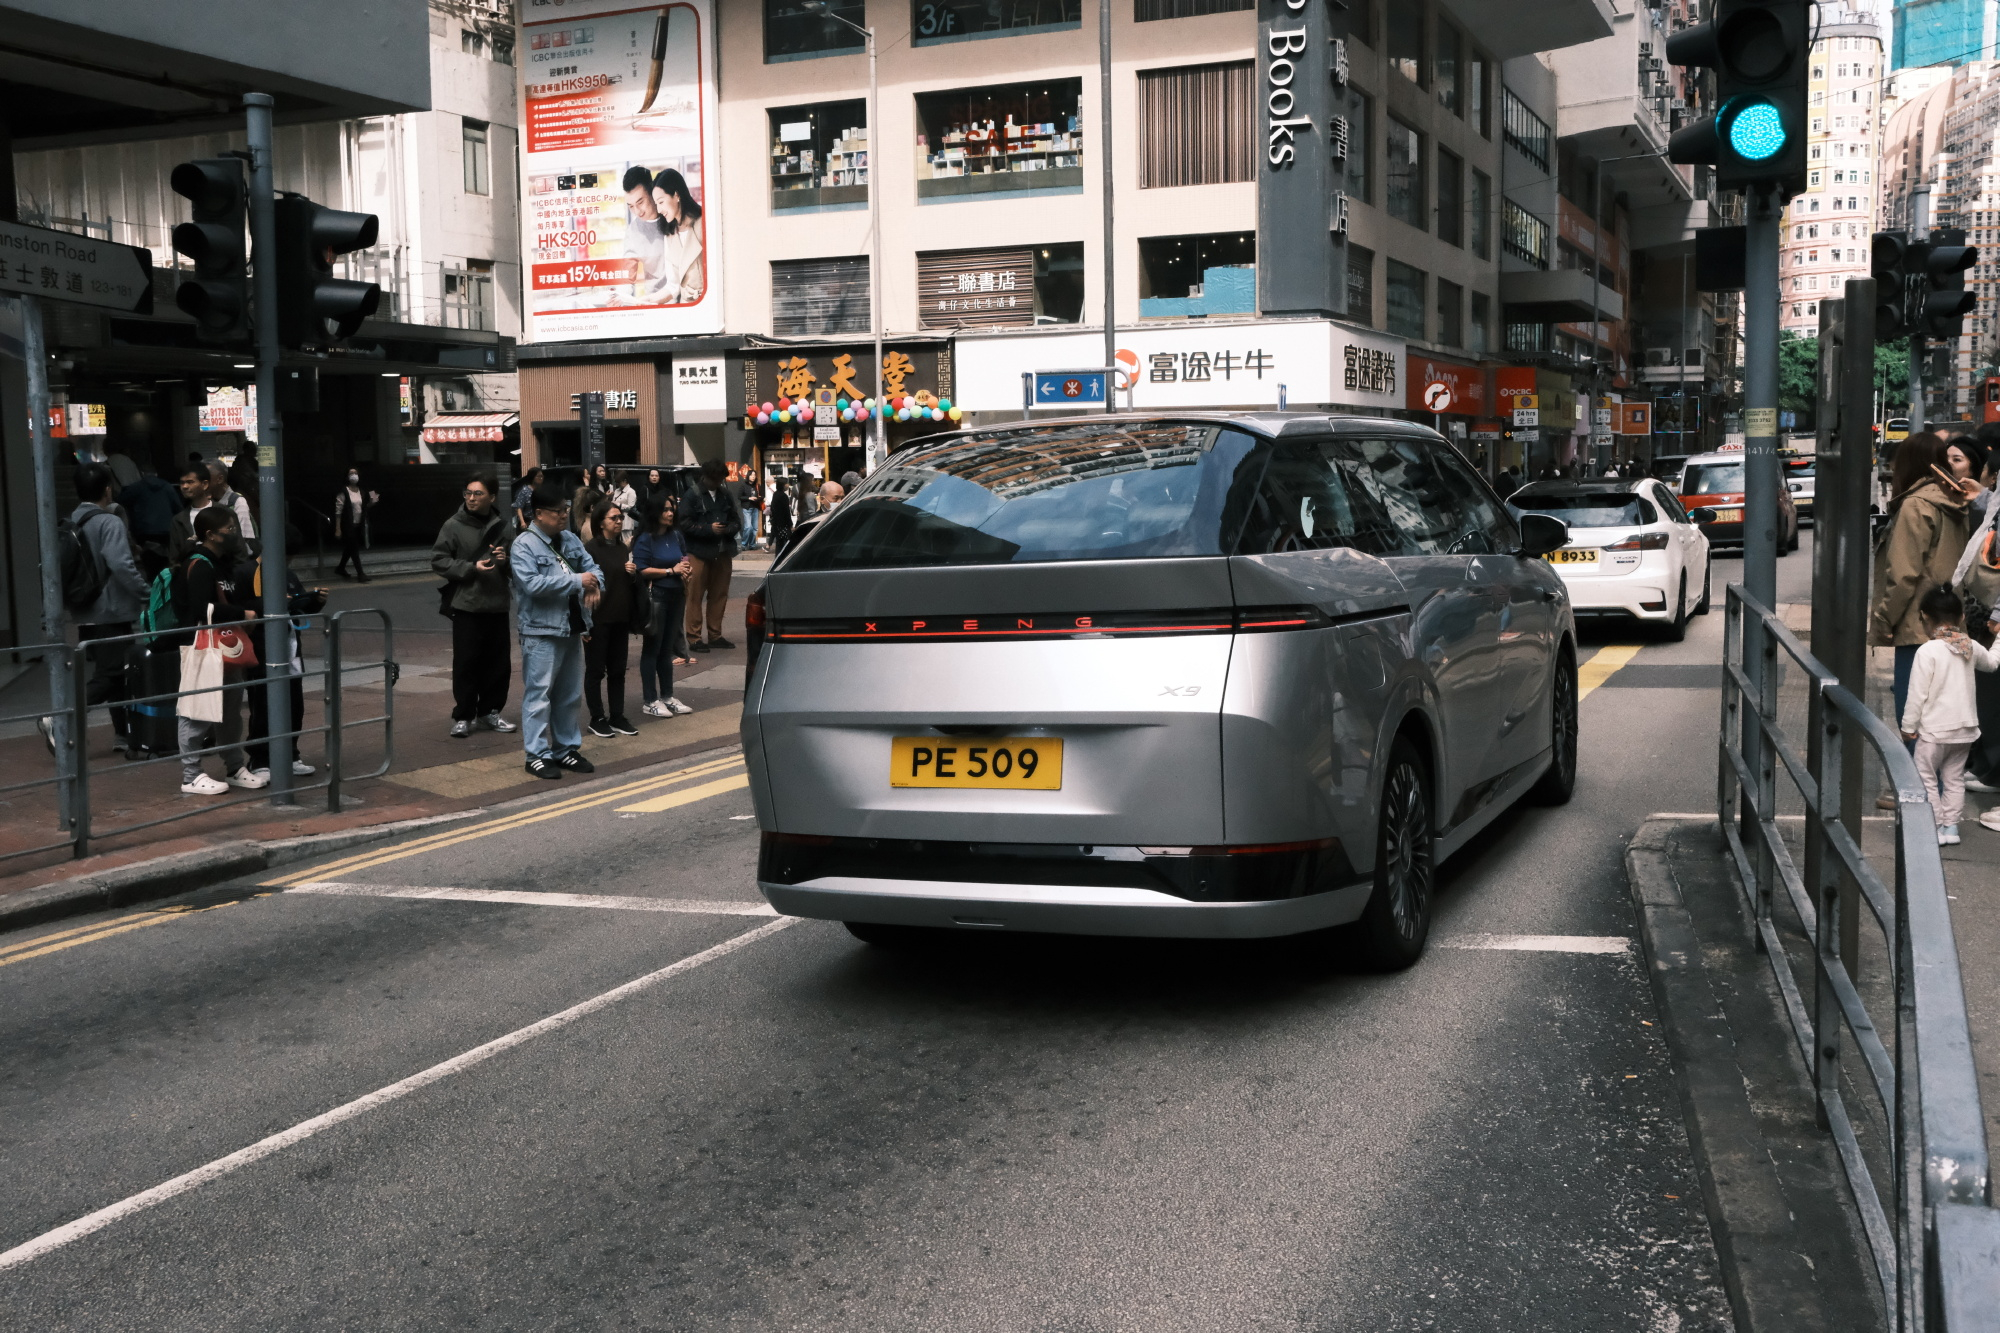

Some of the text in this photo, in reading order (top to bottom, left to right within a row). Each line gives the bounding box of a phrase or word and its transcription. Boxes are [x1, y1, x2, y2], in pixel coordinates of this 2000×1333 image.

[920, 4, 955, 34] 3/F
[1268, 24, 1313, 165] Books
[965, 125, 1036, 156] SALE
[604, 194, 617, 203] Pay
[538, 230, 597, 249] HK$200
[56, 241, 97, 263] Road
[938, 271, 1016, 294] 三聯書店
[540, 324, 599, 333] www.icbcasia.com
[1148, 348, 1274, 383] 富途牛牛
[1344, 344, 1396, 393] 富途證券
[777, 351, 915, 402] 海天堂
[569, 389, 637, 410] 三書店
[210, 407, 242, 417] 9178 8337
[210, 418, 226, 426] 9022
[228, 417, 243, 426] 1100
[1561, 551, 1596, 562] 8933
[865, 617, 1092, 633] XPENG
[1157, 684, 1202, 698] X9
[911, 747, 1040, 780] PE 509
